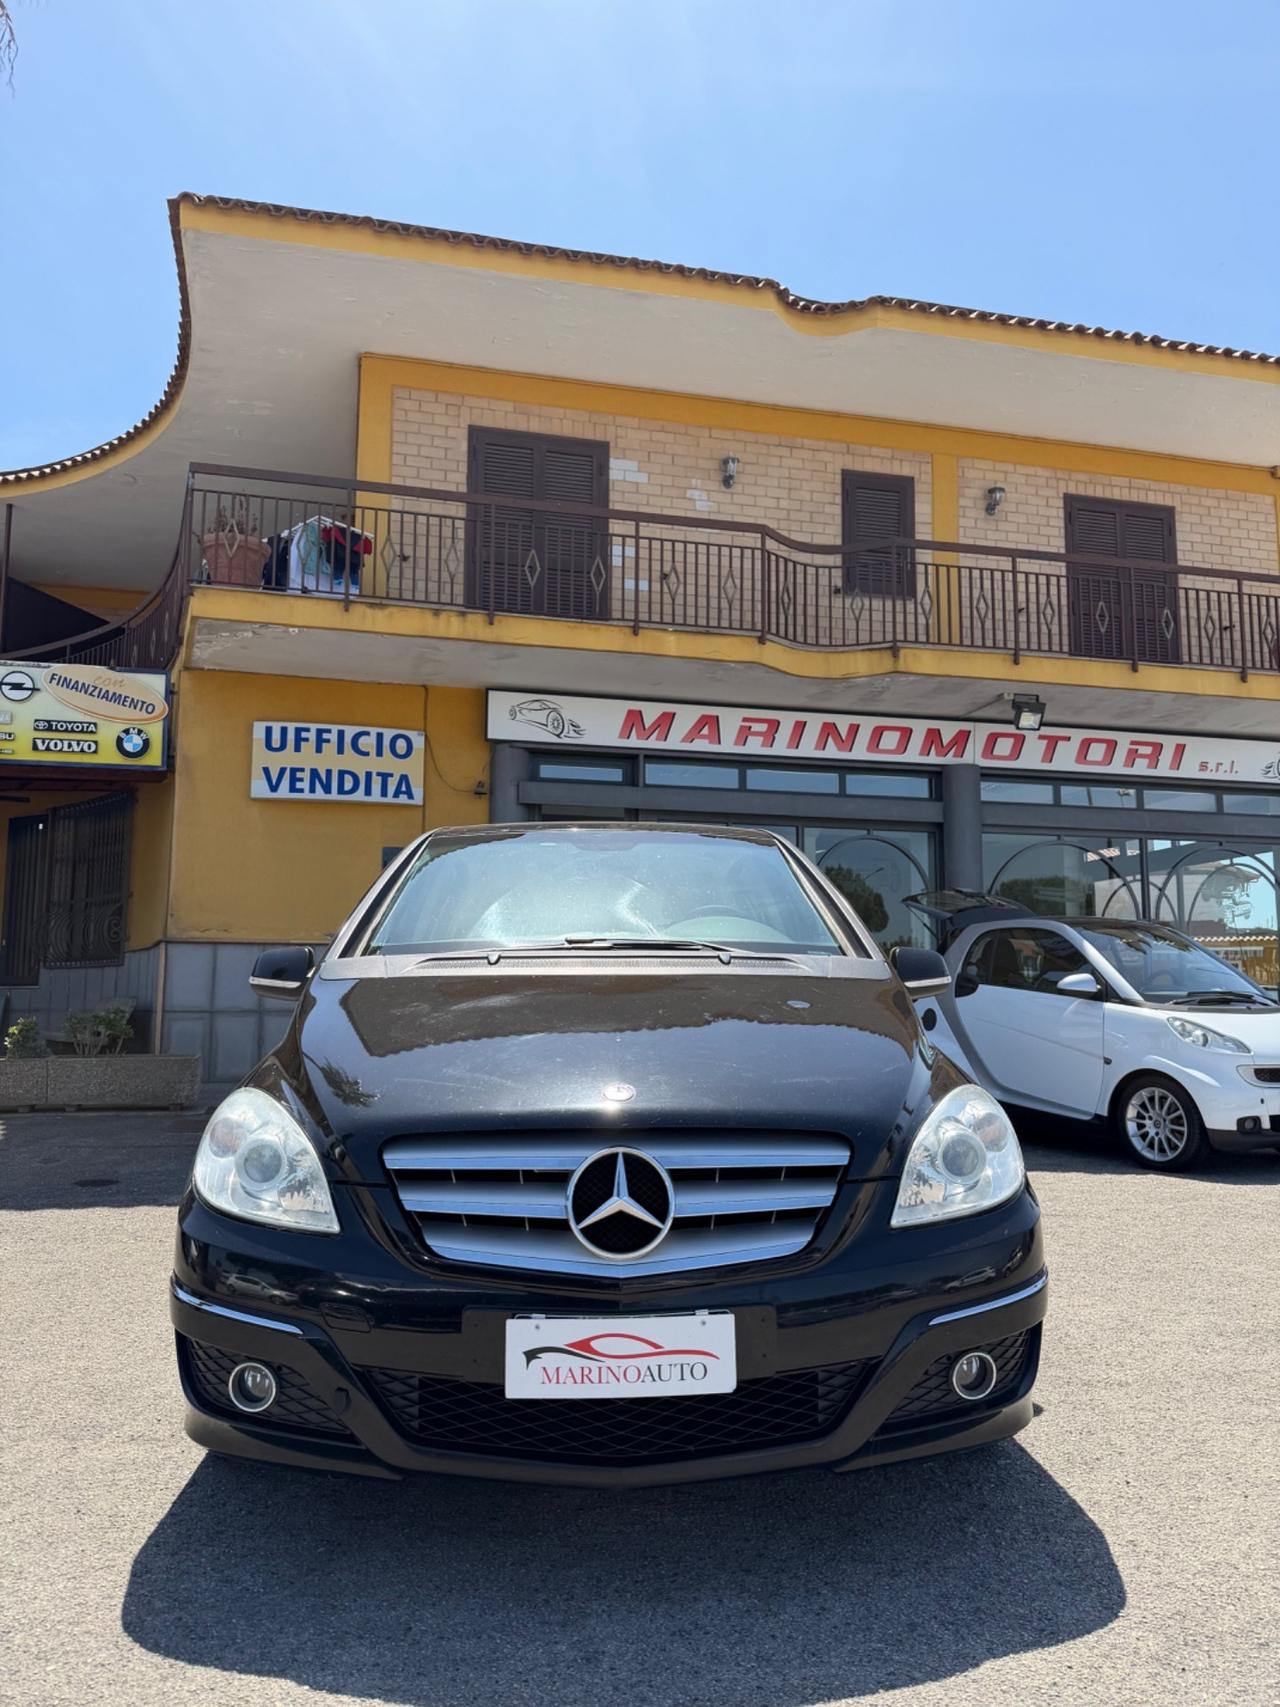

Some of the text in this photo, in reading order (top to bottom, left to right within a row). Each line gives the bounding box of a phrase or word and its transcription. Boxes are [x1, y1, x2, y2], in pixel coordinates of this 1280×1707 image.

[49, 672, 156, 715] FINANZIAMENTO
[52, 722, 97, 732] TOYOTA
[264, 725, 414, 760] UFFICIO
[617, 708, 1239, 775] MARINOMOTORI s.r.l.
[35, 739, 97, 753] VOLVO
[262, 766, 415, 800] VENDITA
[540, 1361, 708, 1385] MARINOAUTO
